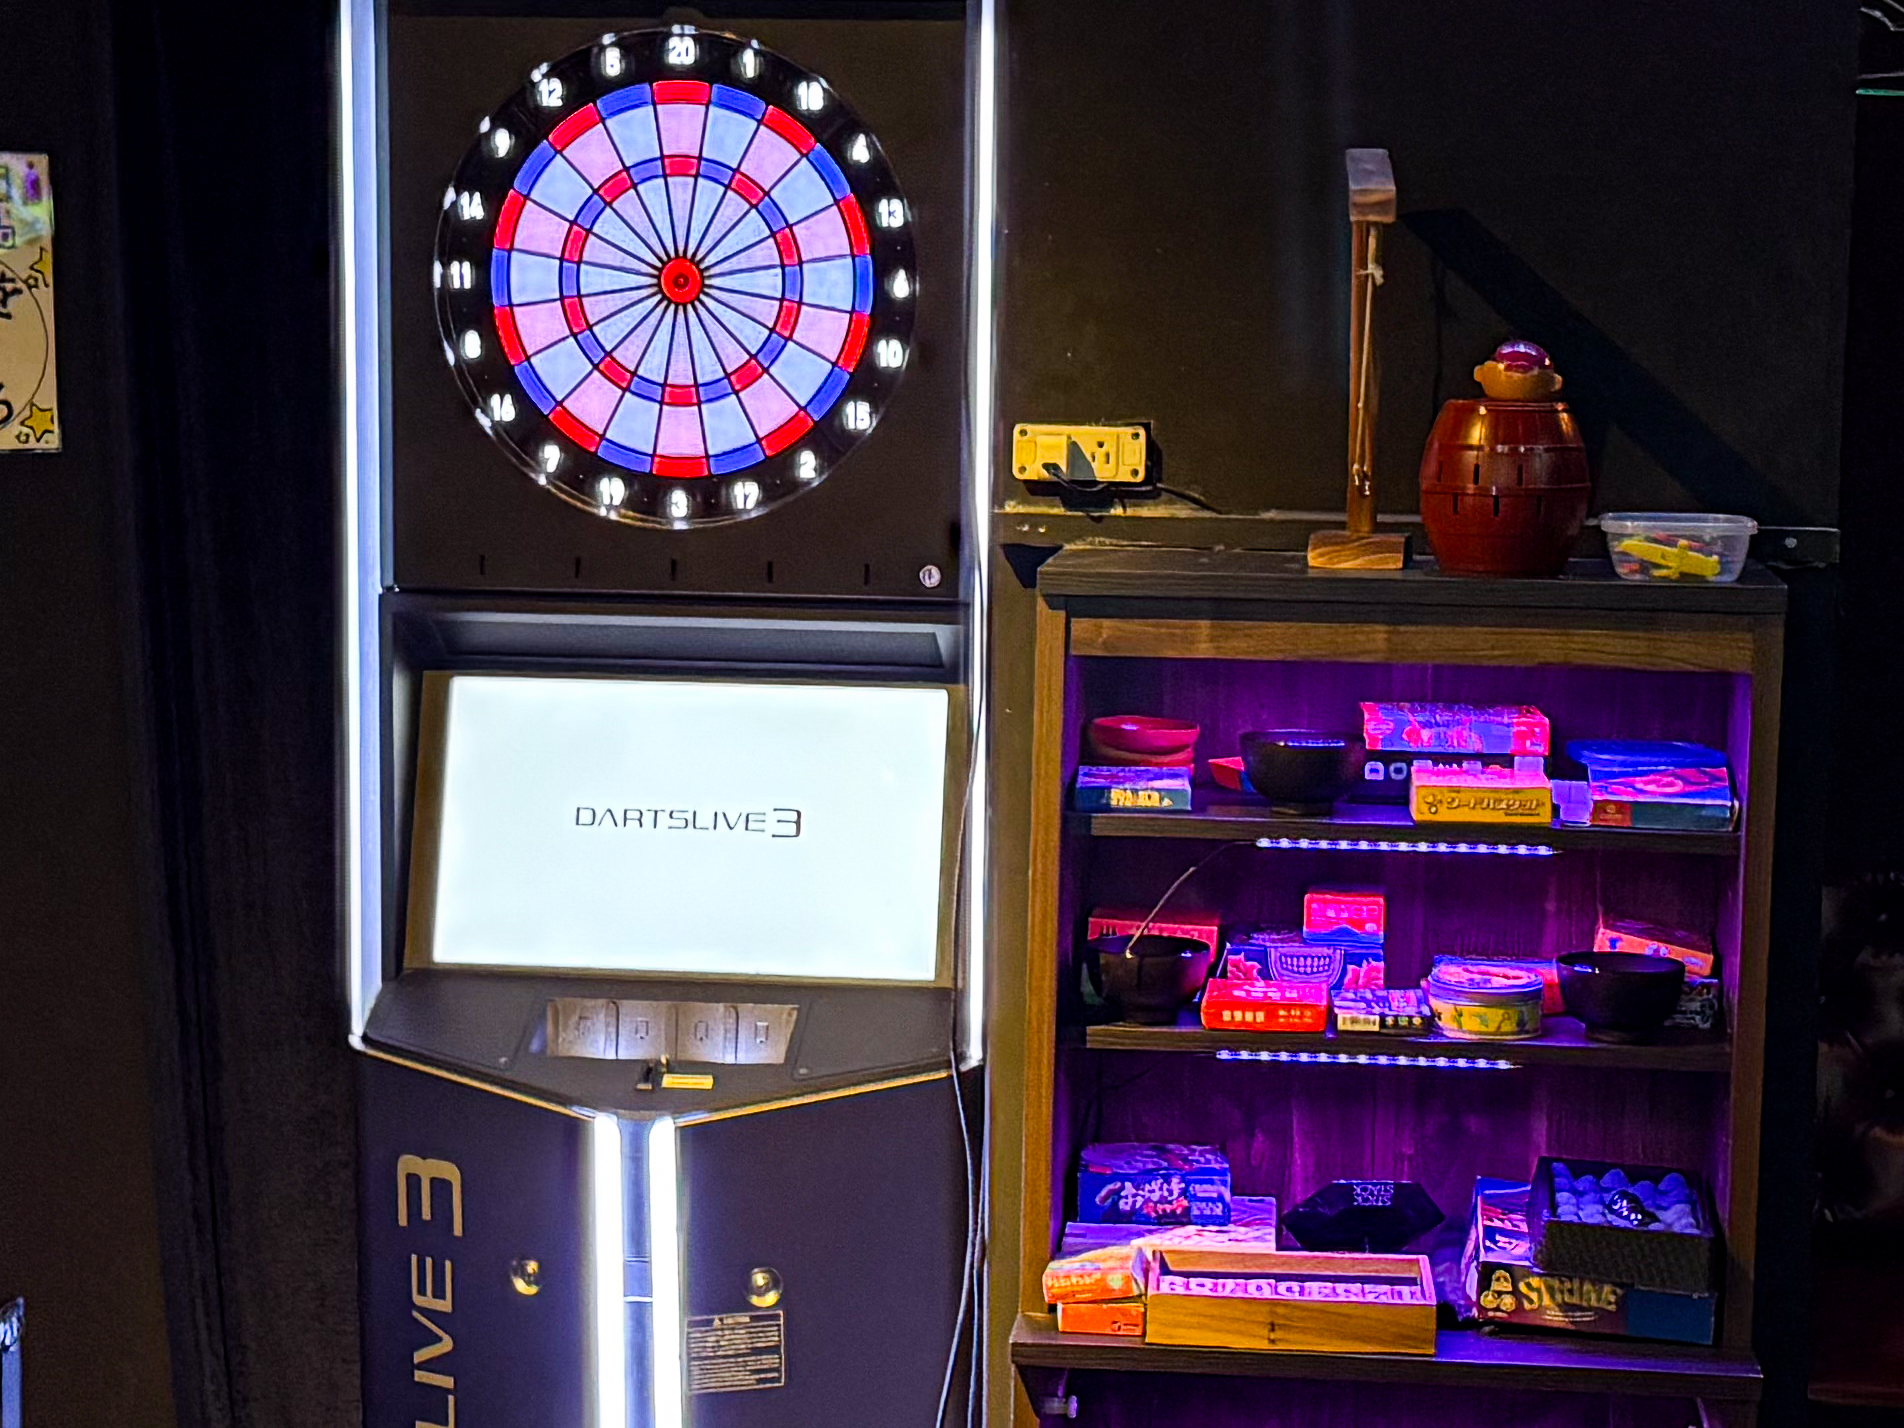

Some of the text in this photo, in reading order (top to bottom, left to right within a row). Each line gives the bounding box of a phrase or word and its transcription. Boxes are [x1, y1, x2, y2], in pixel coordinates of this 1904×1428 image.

[601, 47, 621, 76] 5
[666, 36, 695, 65] 20
[741, 48, 755, 78] 1
[537, 78, 563, 107] 12
[491, 129, 510, 157] 9
[852, 134, 870, 163] 4
[458, 191, 484, 220] 14
[876, 199, 904, 228] 13
[450, 261, 471, 289] 11
[892, 269, 910, 298] 6
[460, 330, 481, 359] 8
[874, 339, 903, 368] 10
[490, 394, 515, 421] 16
[845, 402, 872, 430] 15
[539, 444, 560, 473] 7
[796, 450, 816, 481] 2
[600, 478, 625, 507] 19
[670, 490, 687, 518] 3
[730, 482, 759, 509] 17
